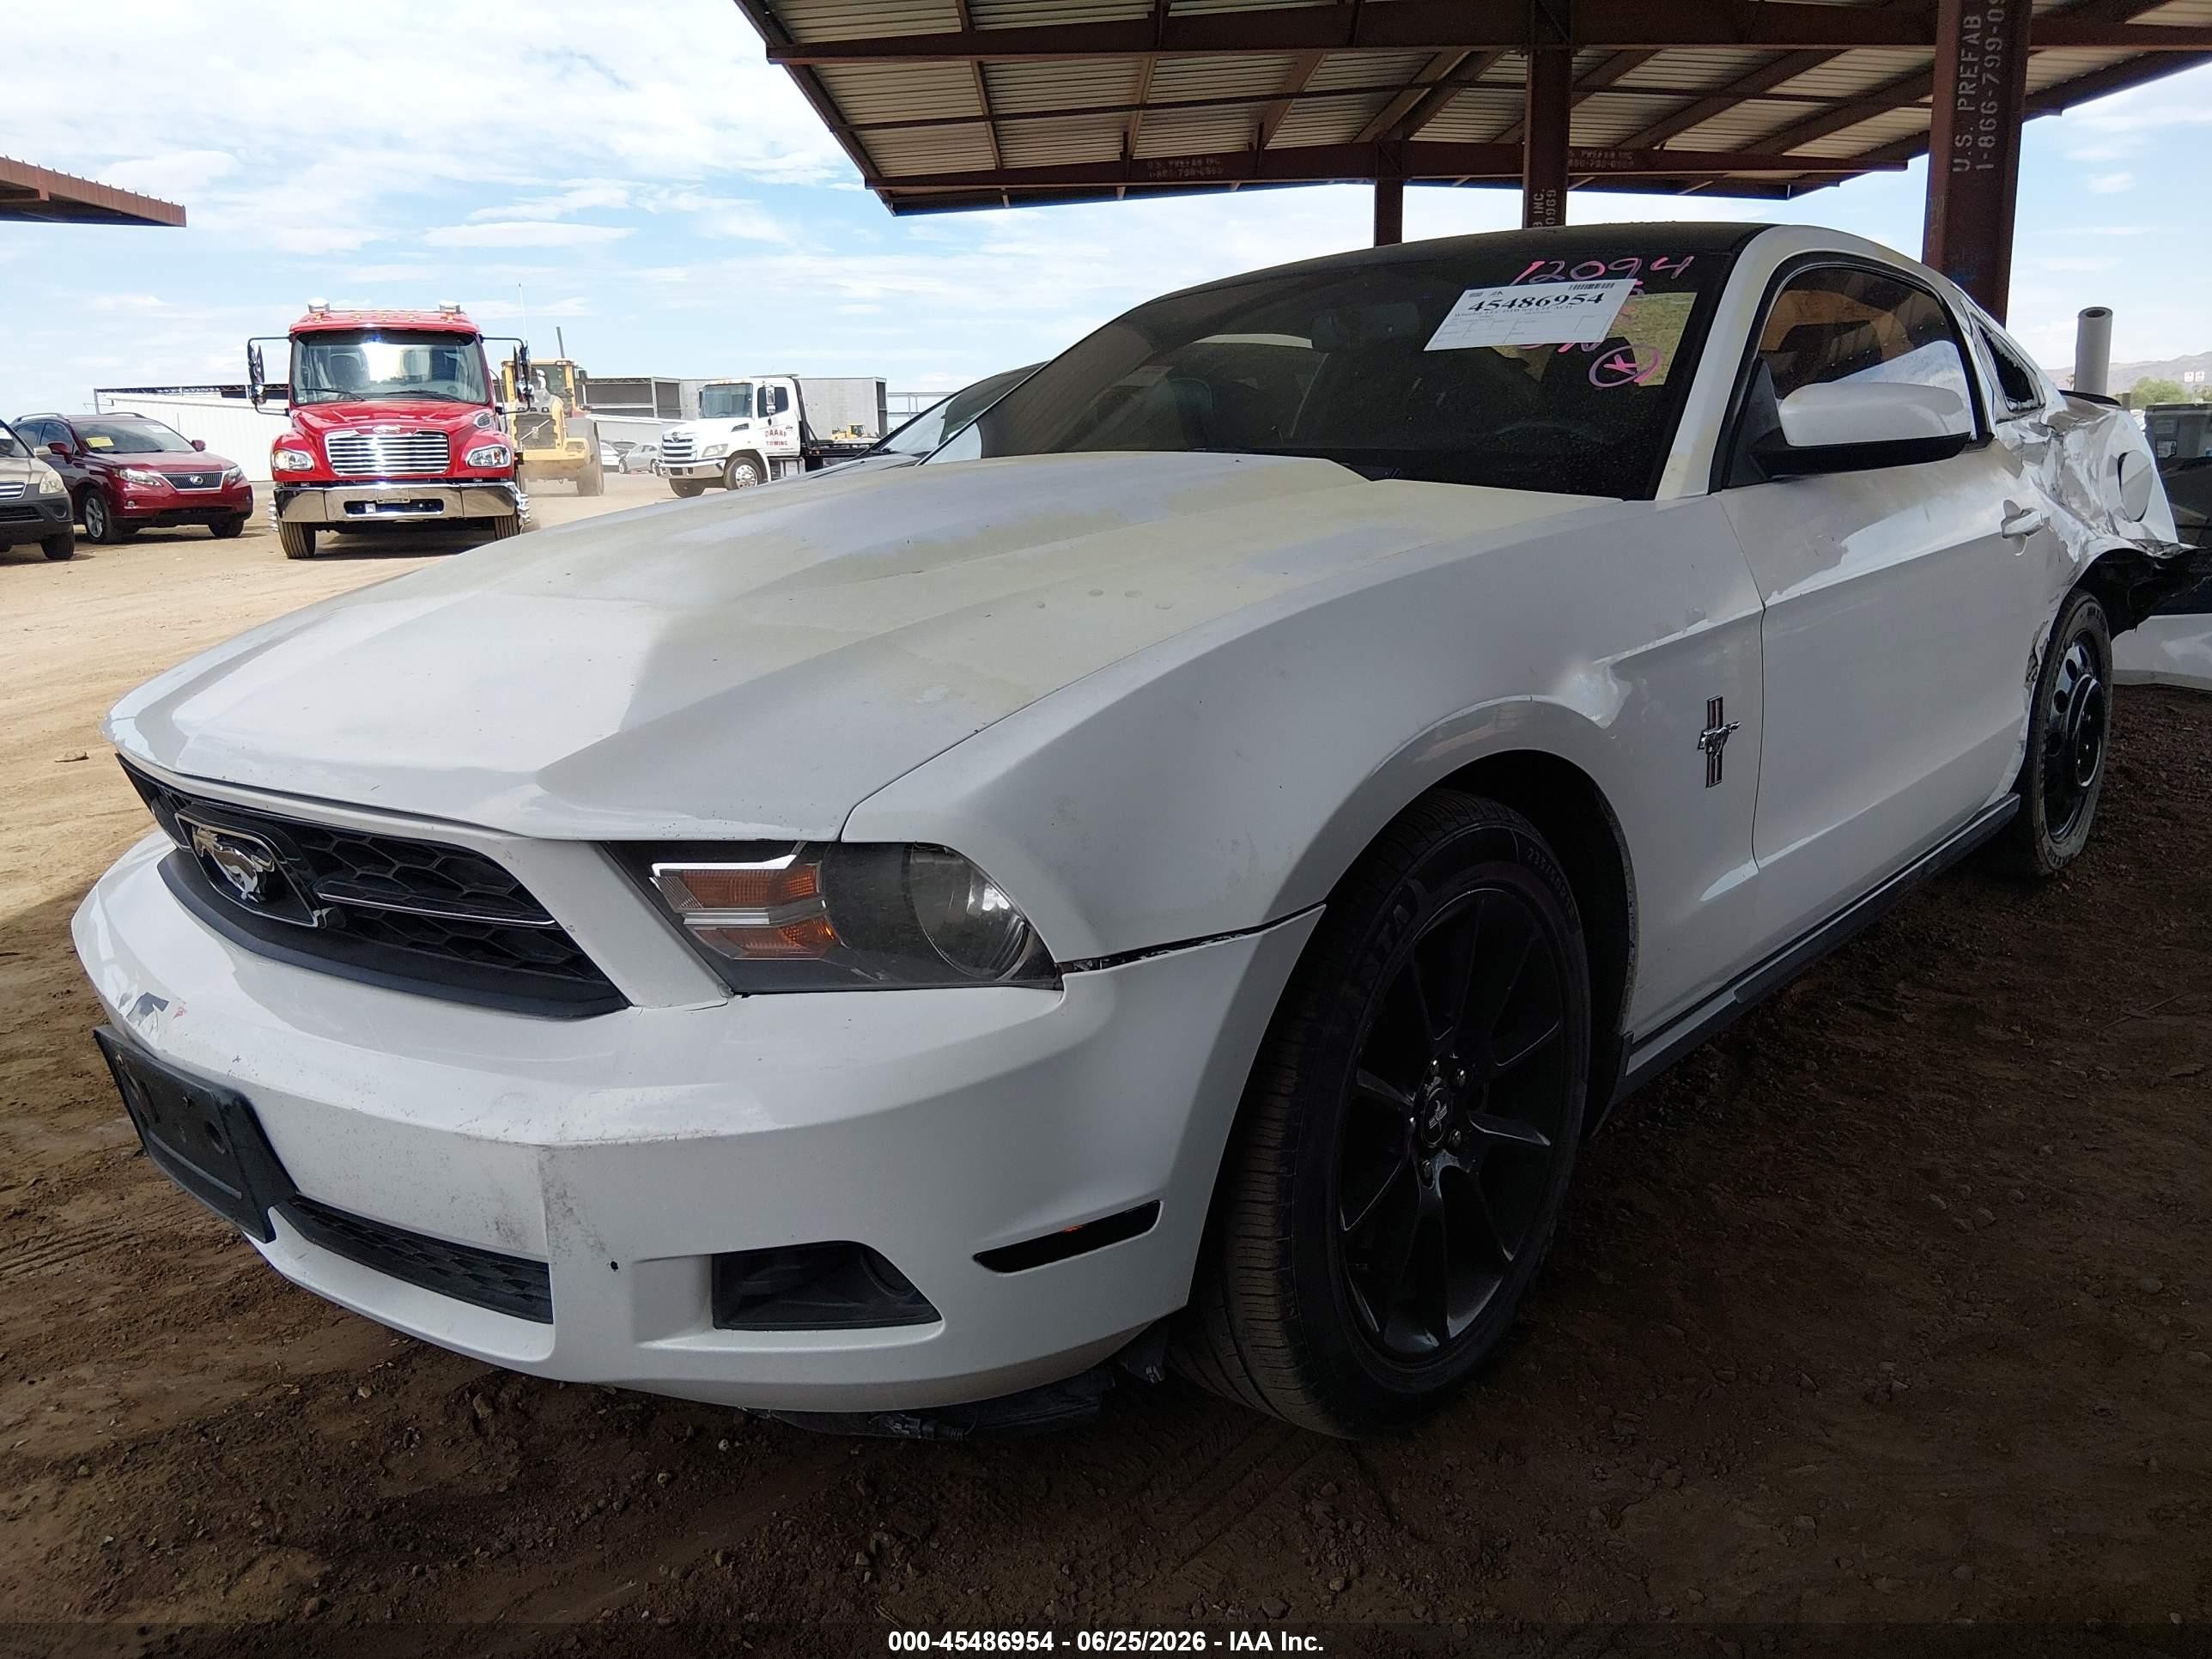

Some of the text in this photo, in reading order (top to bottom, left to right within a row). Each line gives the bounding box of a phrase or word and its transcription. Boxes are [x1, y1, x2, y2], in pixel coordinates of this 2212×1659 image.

[1952, 15, 1982, 172] U.S. PREFAB
[1510, 255, 1695, 286] 12094
[1468, 292, 1605, 312] 45486954
